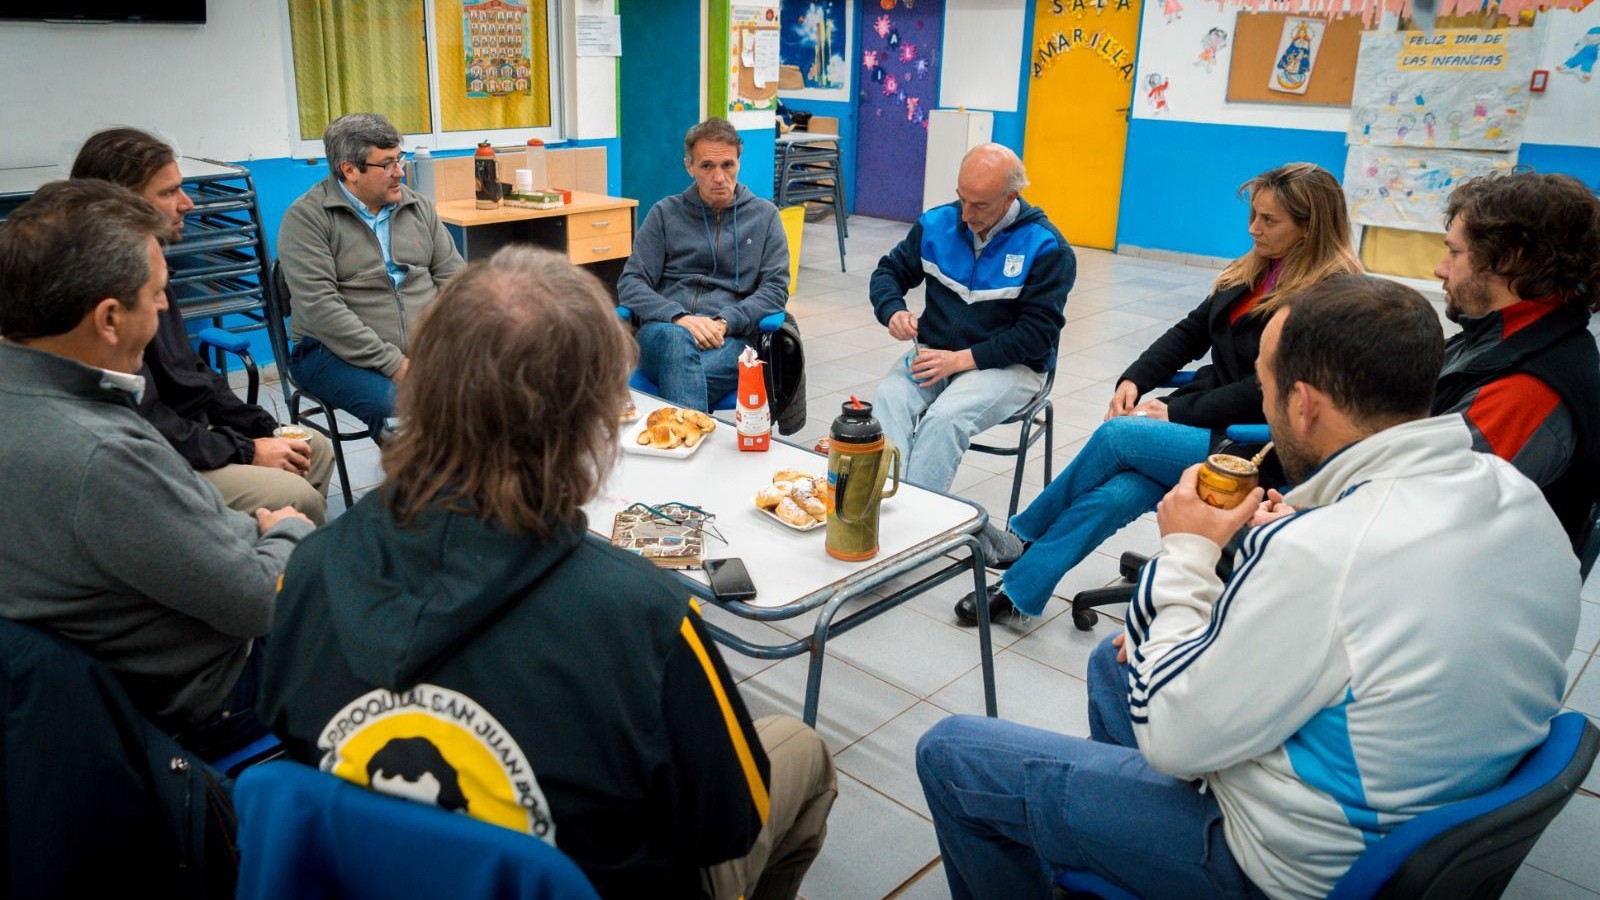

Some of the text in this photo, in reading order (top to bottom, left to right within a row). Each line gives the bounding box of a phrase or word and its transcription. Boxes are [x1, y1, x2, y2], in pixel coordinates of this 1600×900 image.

[1052, 0, 1130, 14] SALA
[1409, 34, 1503, 45] FELIZ DIA DE
[1033, 28, 1134, 79] AMARILLA
[1402, 55, 1503, 66] LAS INFANCIAS
[432, 693, 476, 725] SAN
[474, 722, 523, 776] JUAN
